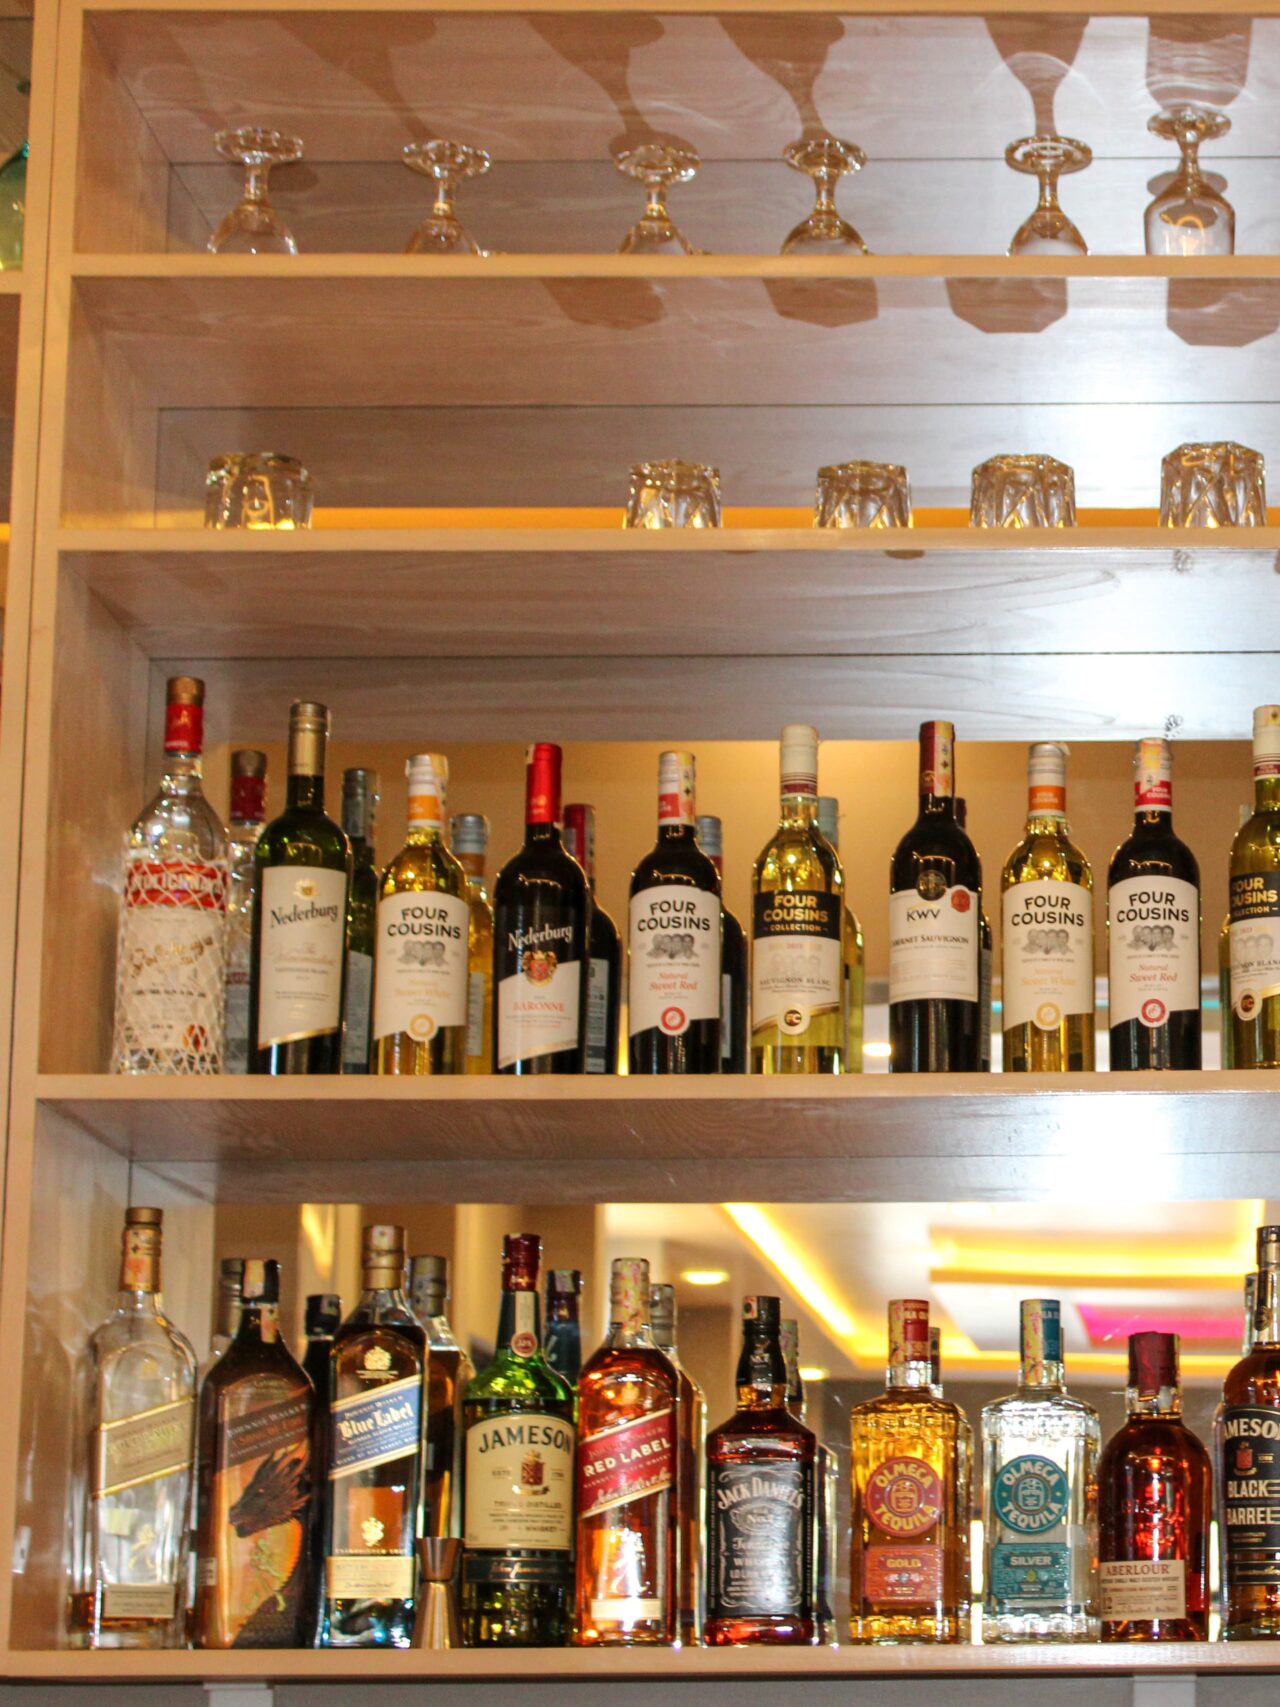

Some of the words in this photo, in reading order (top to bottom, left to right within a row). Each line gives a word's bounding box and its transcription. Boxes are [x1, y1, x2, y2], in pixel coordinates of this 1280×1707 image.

[774, 894, 817, 907] FOUR
[1024, 896, 1071, 910] FOUR
[1129, 891, 1176, 906] FOUR
[270, 901, 338, 929] Nederburg
[401, 906, 448, 922] FOUR
[649, 900, 696, 915] FOUR
[763, 909, 829, 922] COUSINS
[906, 909, 941, 922] KWV
[1011, 913, 1085, 927] COUSINS
[1116, 908, 1190, 923] COUSINS
[387, 922, 462, 939] COUSINS
[637, 916, 711, 931] COUSINS
[770, 924, 822, 932] COLLECTION
[508, 924, 573, 951] Nederburg
[921, 934, 969, 944] SAUVIGNON
[649, 981, 677, 991] Sweet
[680, 980, 698, 990] Red
[1129, 973, 1157, 983] Sweet
[1160, 973, 1178, 982] Red
[513, 1002, 565, 1012] BARONNE
[336, 1417, 374, 1438] Blue
[371, 1402, 415, 1427] Label
[479, 1425, 571, 1454] JAMESON
[583, 1457, 616, 1477] RED
[619, 1437, 671, 1463] LABEL
[875, 1463, 934, 1489] OLMECA
[1002, 1460, 1060, 1486] OLMECA
[717, 1483, 751, 1509] JACK
[752, 1477, 805, 1509] DANIEL'S
[1228, 1480, 1271, 1498] BLACK
[874, 1503, 938, 1531] TEQUILA
[1001, 1502, 1063, 1529] TEQUILA
[1227, 1507, 1276, 1525] BARREL
[886, 1558, 921, 1569] GOLD
[1010, 1555, 1052, 1566] SILVER
[1106, 1564, 1170, 1577] ABERLOUR
